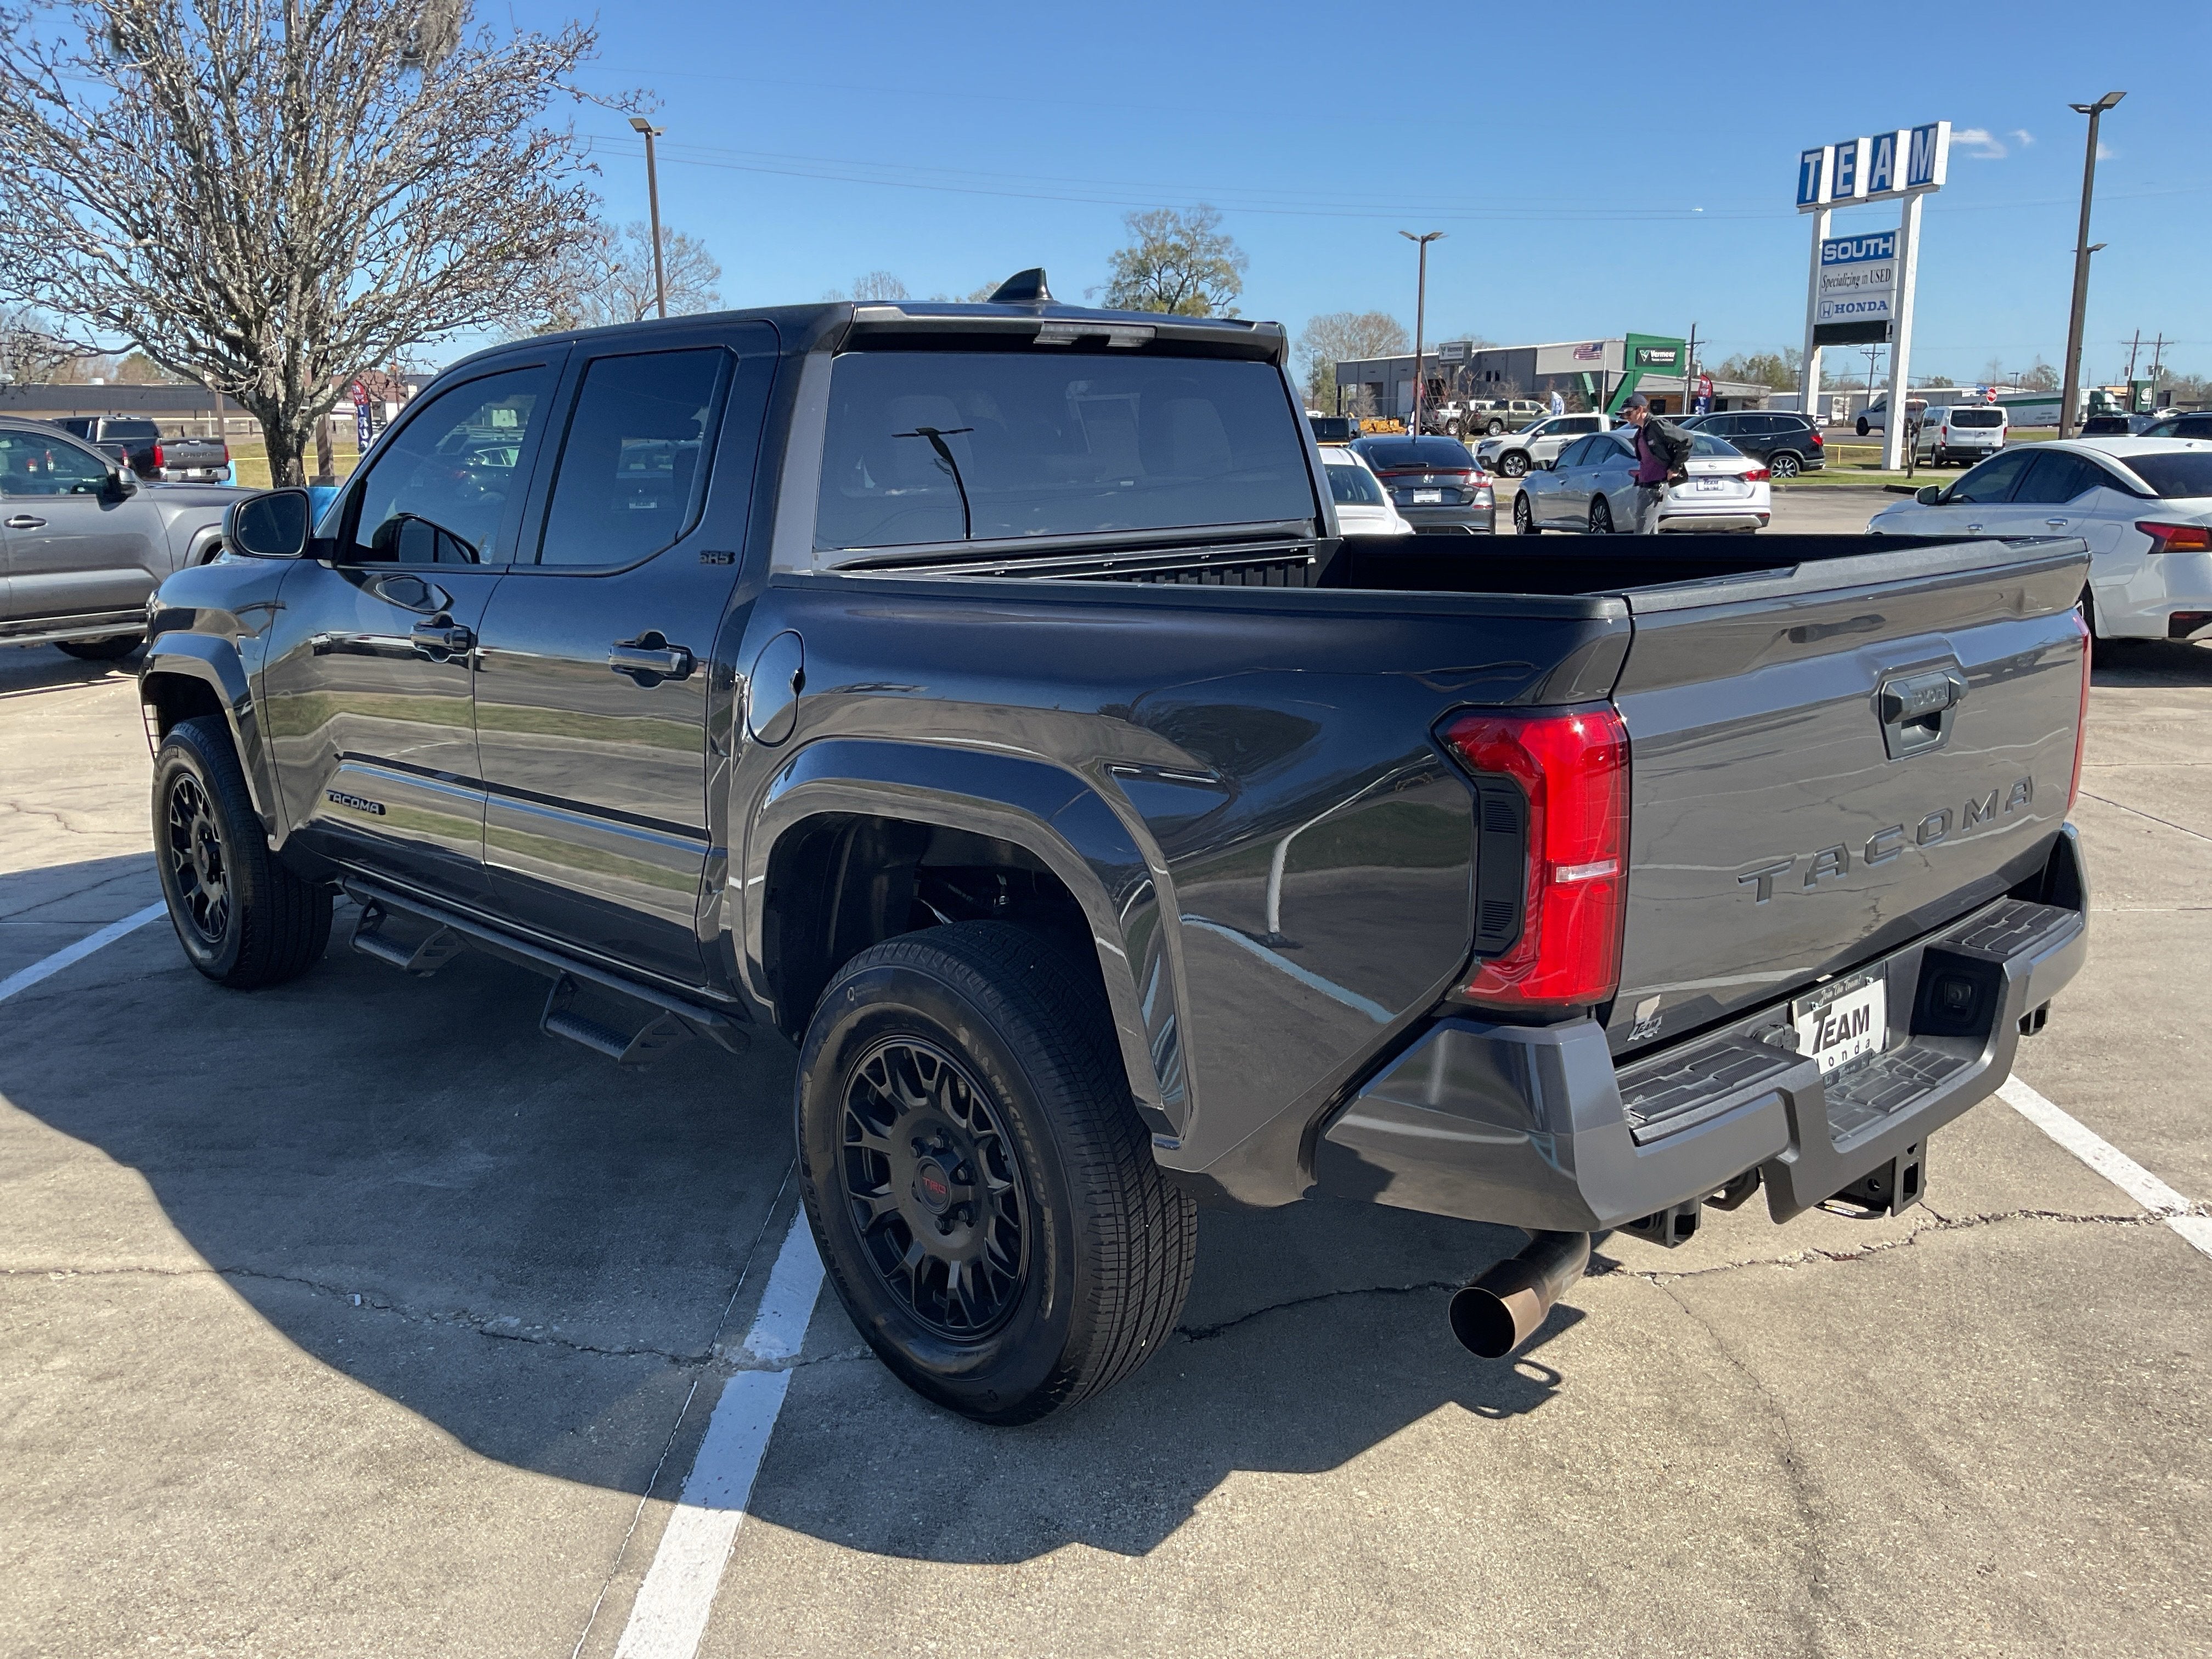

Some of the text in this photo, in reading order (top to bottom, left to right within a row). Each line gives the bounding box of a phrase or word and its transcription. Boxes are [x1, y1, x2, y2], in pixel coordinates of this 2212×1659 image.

[1803, 127, 1938, 201] TEAM
[1824, 236, 1894, 261] SOUTH
[1821, 268, 1891, 292] Specializing in USED
[1834, 300, 1888, 314] HONDA
[1988, 391, 1997, 399] STOP
[1912, 684, 1948, 708] TOYOTA
[326, 790, 380, 815] TACOMA
[1737, 775, 2033, 905] TACOMA
[922, 1176, 947, 1194] TRD
